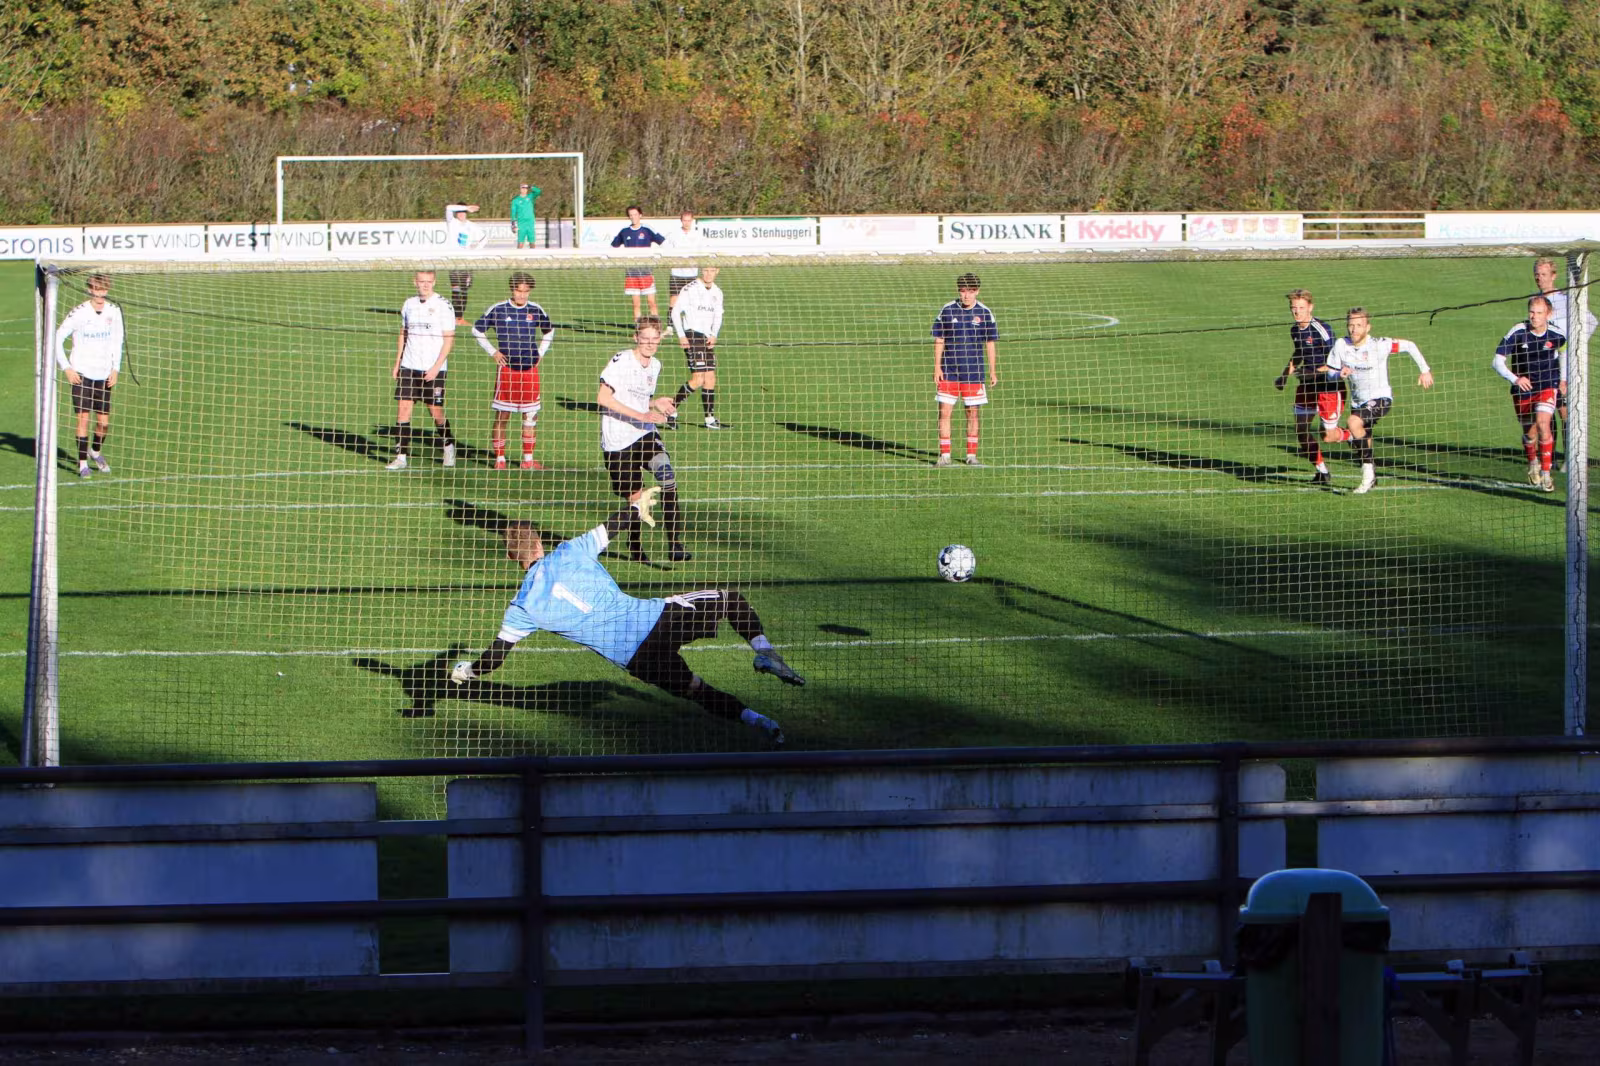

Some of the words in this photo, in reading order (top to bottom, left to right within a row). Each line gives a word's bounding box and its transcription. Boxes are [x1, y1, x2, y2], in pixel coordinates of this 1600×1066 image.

[336, 230, 395, 245] WEST
[398, 229, 447, 245] WIND
[702, 227, 747, 240] Næslev's
[752, 225, 812, 241] Stenhuggeri
[950, 222, 1053, 241] SYDBANK
[1078, 219, 1165, 242] Kvickly
[90, 235, 149, 249] WEST
[151, 233, 200, 249] WIND
[213, 232, 272, 248] WEST
[274, 231, 325, 247] WIND
